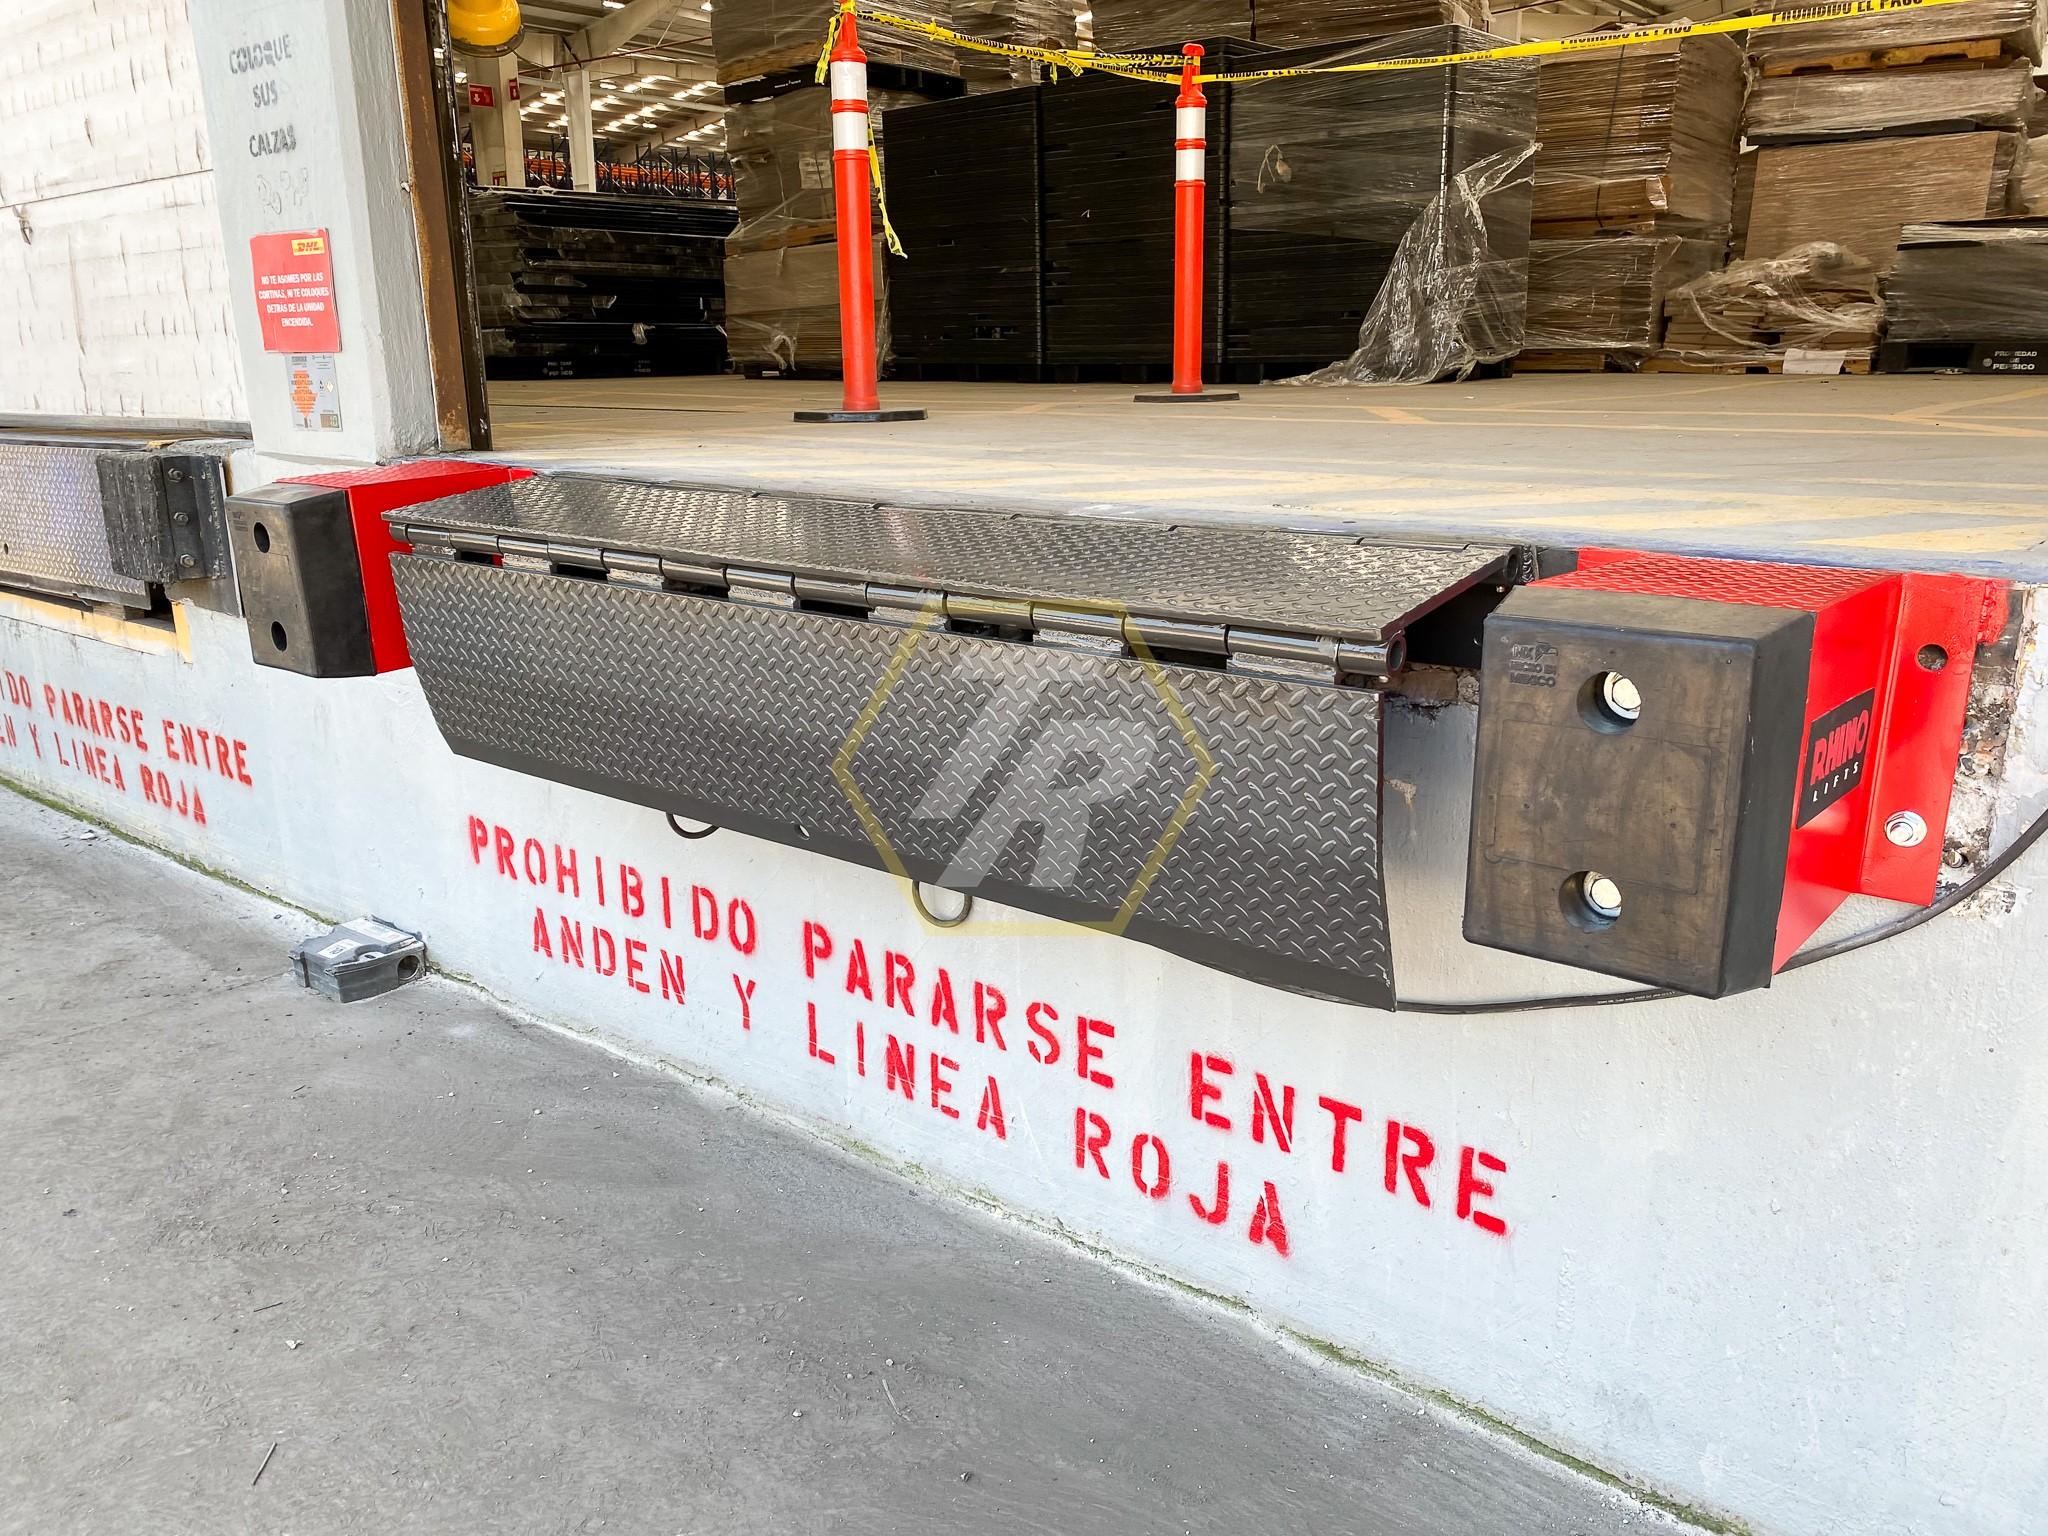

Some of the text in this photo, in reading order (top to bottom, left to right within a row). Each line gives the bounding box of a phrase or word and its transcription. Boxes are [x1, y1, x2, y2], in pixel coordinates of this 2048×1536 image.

[229, 34, 292, 74] COLOQUE
[253, 79, 278, 108] SUS
[249, 125, 297, 158] CALZAS
[297, 241, 321, 252] DHL
[261, 275, 270, 285] NO
[270, 275, 278, 284] TE
[300, 273, 312, 283] POR
[313, 272, 324, 282] LAS
[293, 288, 301, 297] TE
[301, 287, 330, 298] COLOQUES
[288, 303, 297, 312] DE
[296, 303, 304, 312] LA
[303, 302, 325, 312] UNIDAD
[43, 683, 149, 753] PARARSE
[162, 718, 253, 787] ENTRE
[1810, 709, 1869, 786] RHINO
[28, 721, 42, 760] Y
[54, 730, 127, 792] LINEA
[139, 763, 207, 827] ROJA
[1812, 761, 1859, 803] LIFTS
[468, 814, 1508, 1237] PROHIBIDO PARARSE ENTRE
[532, 906, 1291, 1260] ANDEN Y LINEA ROJA
